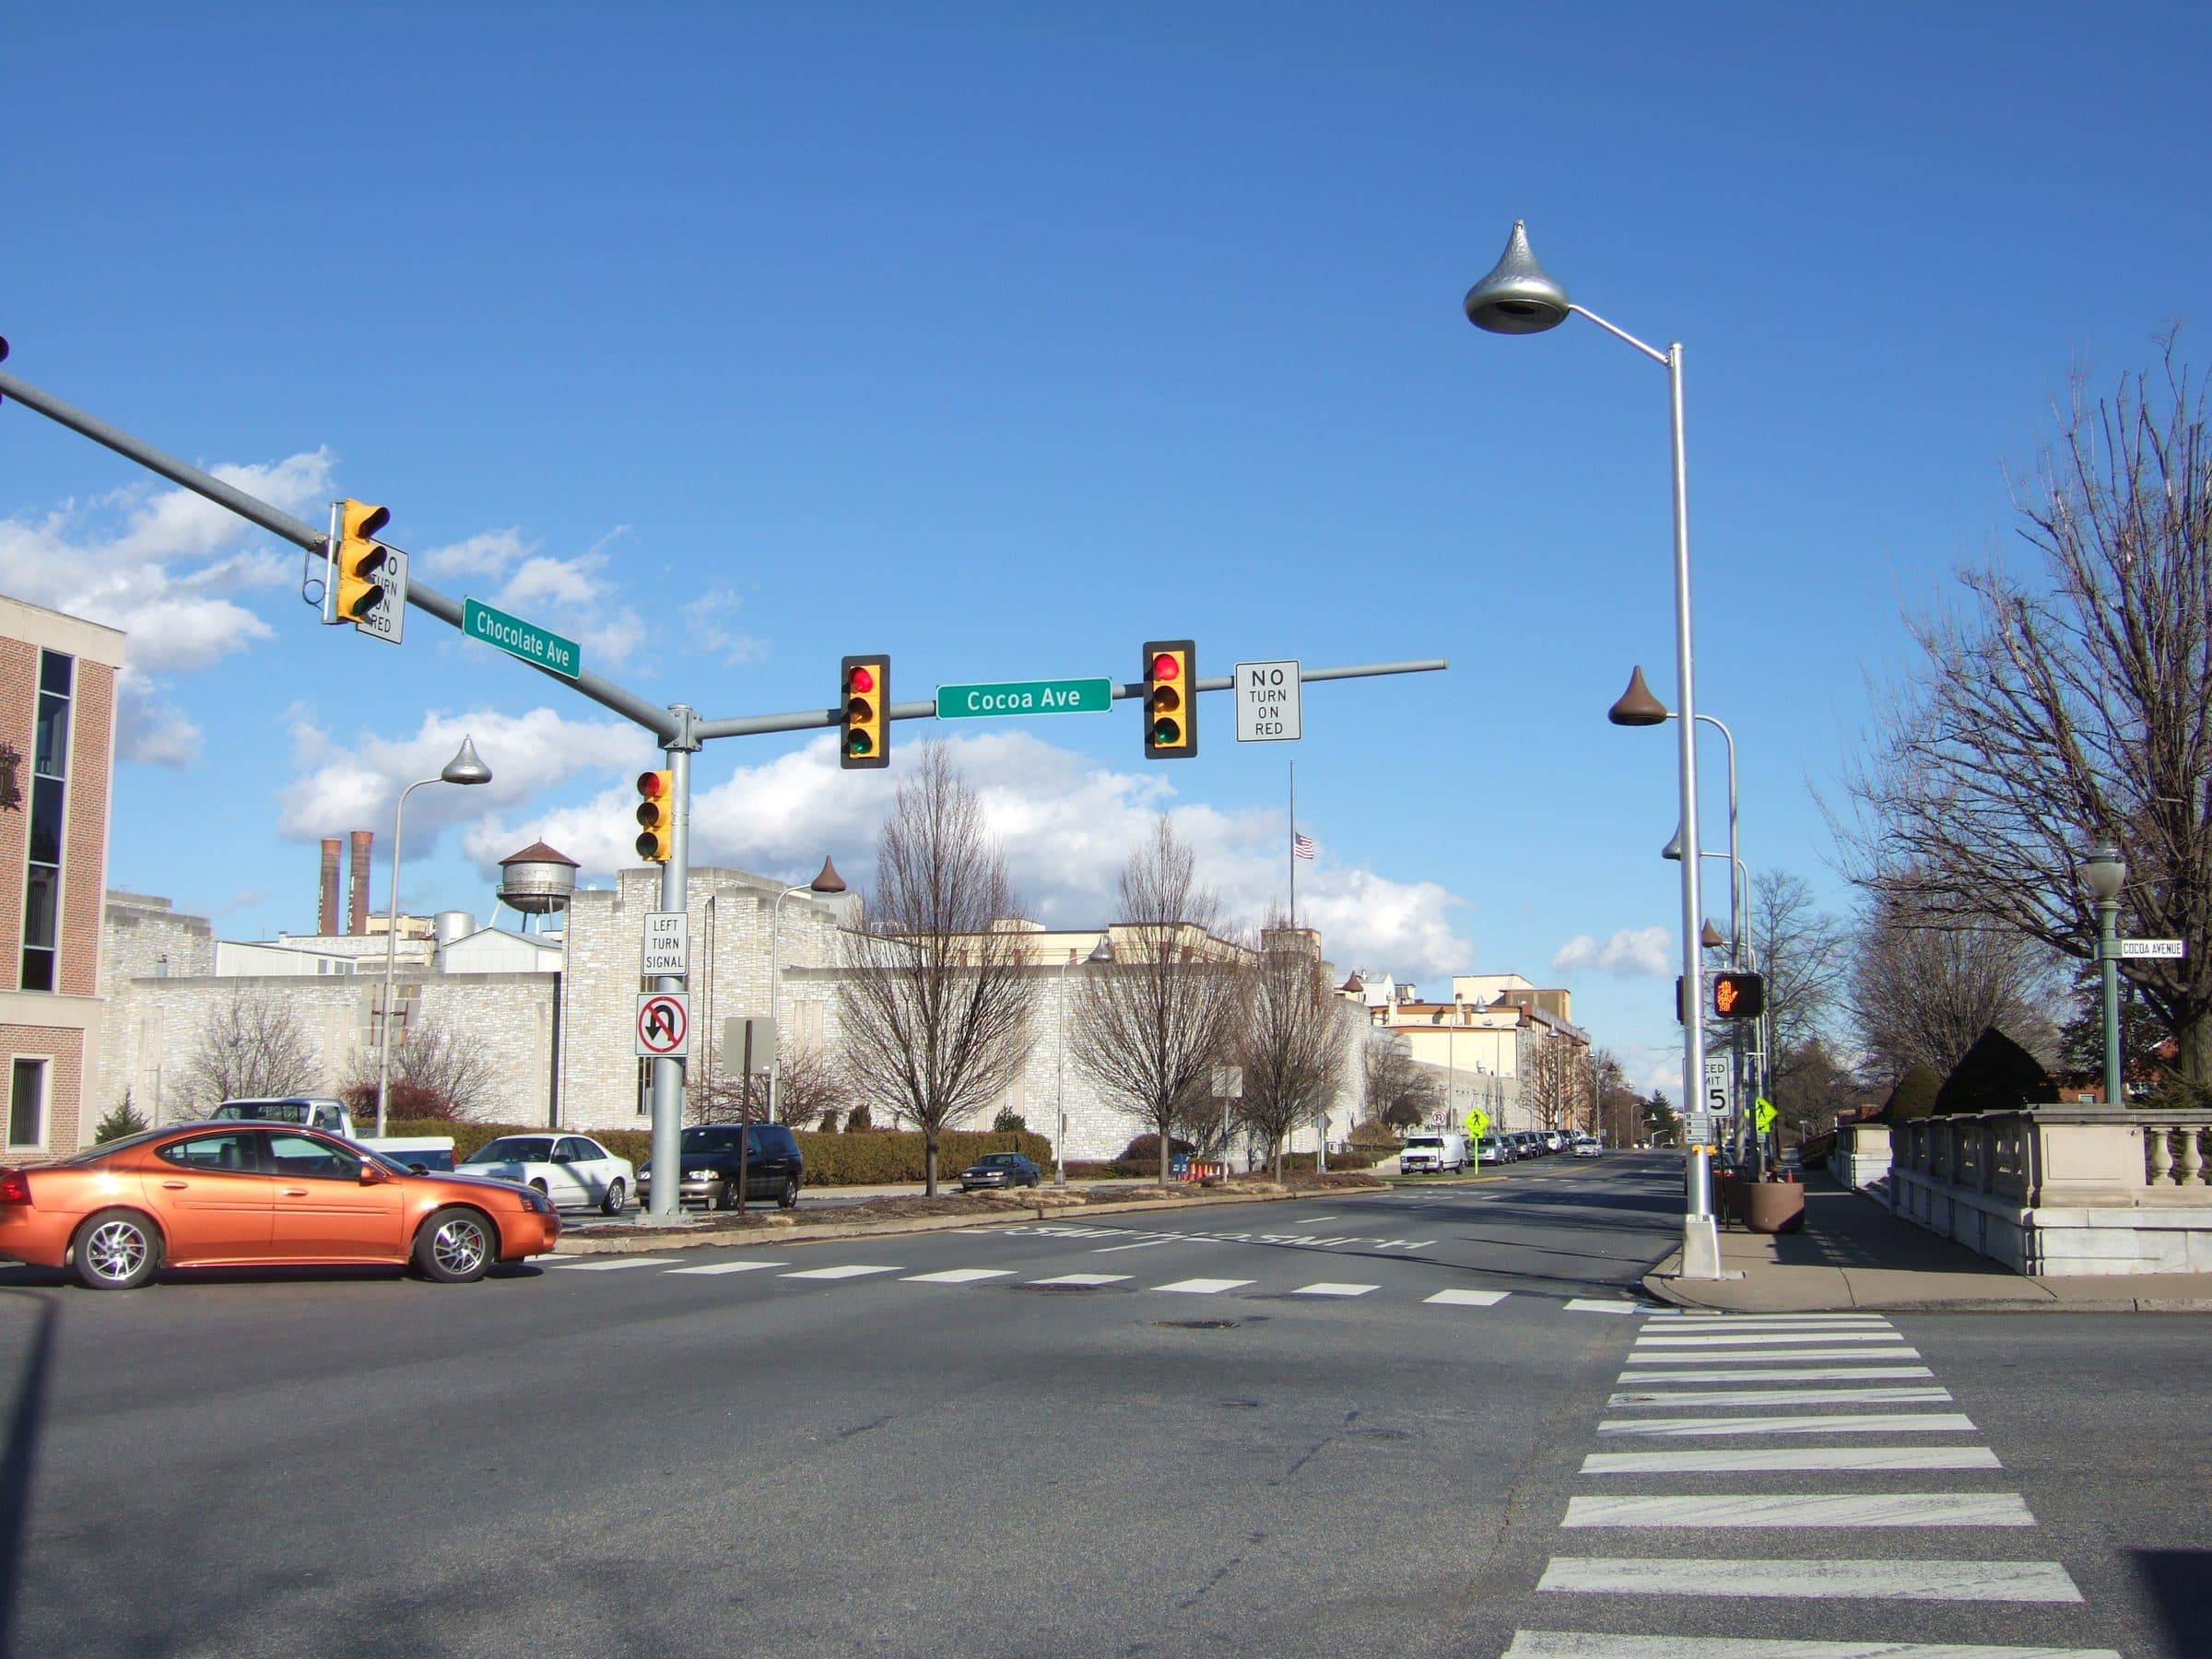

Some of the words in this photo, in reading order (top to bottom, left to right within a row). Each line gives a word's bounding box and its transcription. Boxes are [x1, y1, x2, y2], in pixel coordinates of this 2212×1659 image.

[371, 615, 391, 633] RED
[477, 611, 543, 656] Chocolate
[547, 641, 570, 666] Ave
[1252, 669, 1284, 687] NO
[968, 691, 1032, 711] Cocoa
[1041, 688, 1081, 707] Ave
[1249, 689, 1287, 702] TURN
[1258, 706, 1278, 719] ON
[1255, 723, 1283, 735] RED
[653, 919, 678, 932] LEFT
[653, 937, 679, 950] TURN
[2123, 943, 2149, 955] COCOA
[2152, 943, 2182, 955] AVENUE
[646, 956, 683, 968] SIGNAL
[1704, 1064, 1725, 1074] EED
[1710, 1088, 1726, 1111] 5
